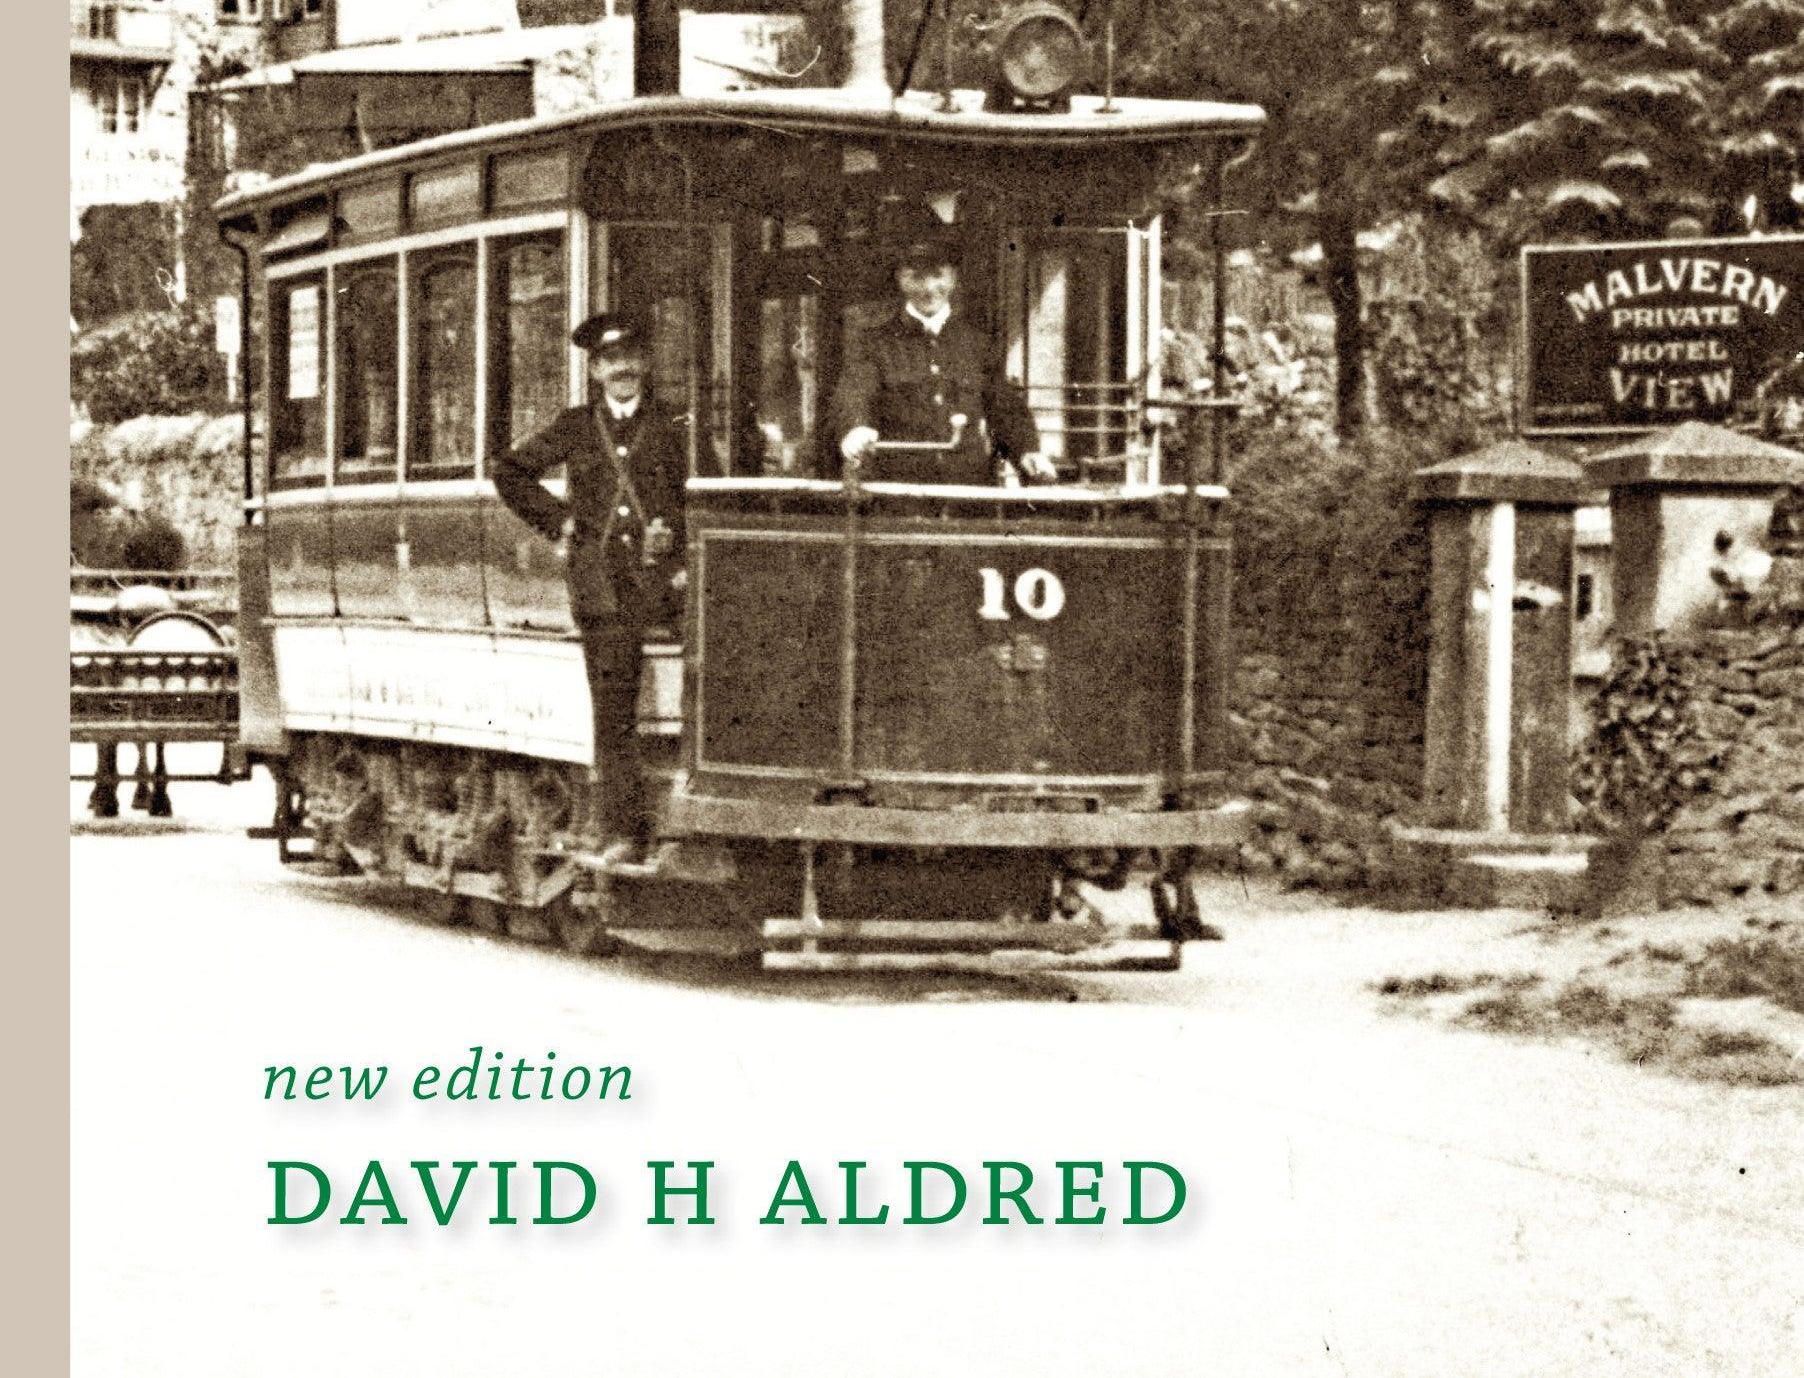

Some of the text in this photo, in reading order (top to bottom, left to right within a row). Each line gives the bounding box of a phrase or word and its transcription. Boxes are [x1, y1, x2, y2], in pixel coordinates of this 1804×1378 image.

[1565, 258, 1788, 322] MALVERN
[1612, 305, 1740, 329] PRIVATE
[1620, 339, 1729, 363] HOTEL
[1610, 367, 1734, 408] VIEW
[977, 567, 1066, 620] 10
